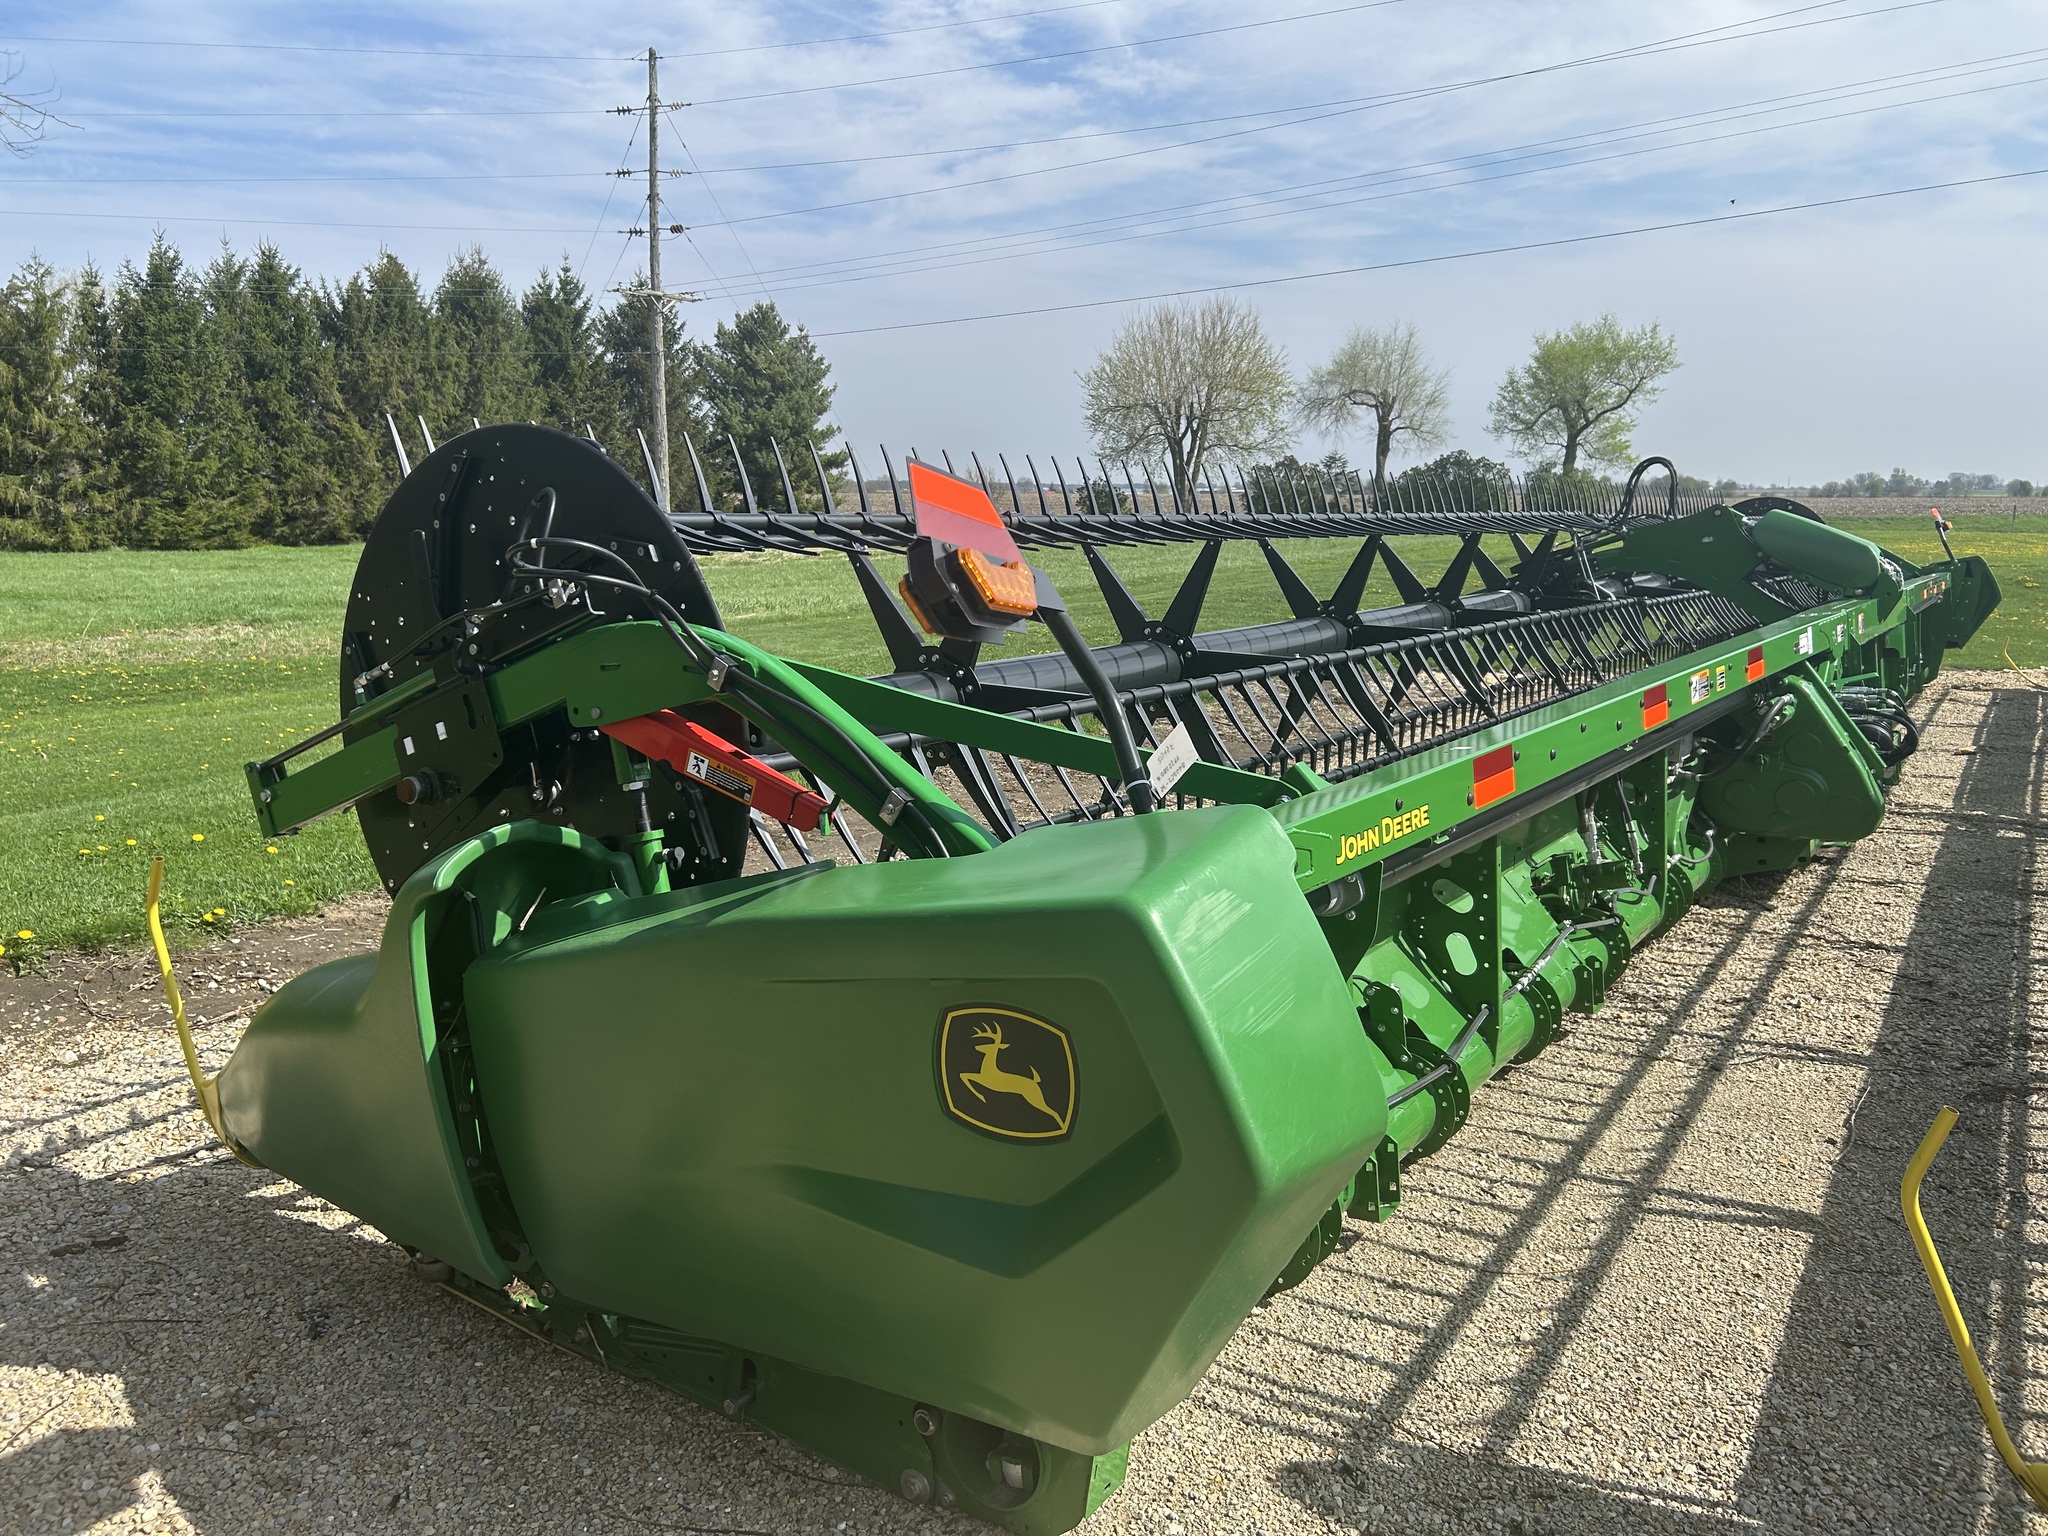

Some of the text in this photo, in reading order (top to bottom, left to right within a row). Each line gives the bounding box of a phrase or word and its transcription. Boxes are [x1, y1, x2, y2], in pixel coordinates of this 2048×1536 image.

[723, 765, 749, 782] WARNING
[1336, 803, 1430, 865] JOHN DEERE
